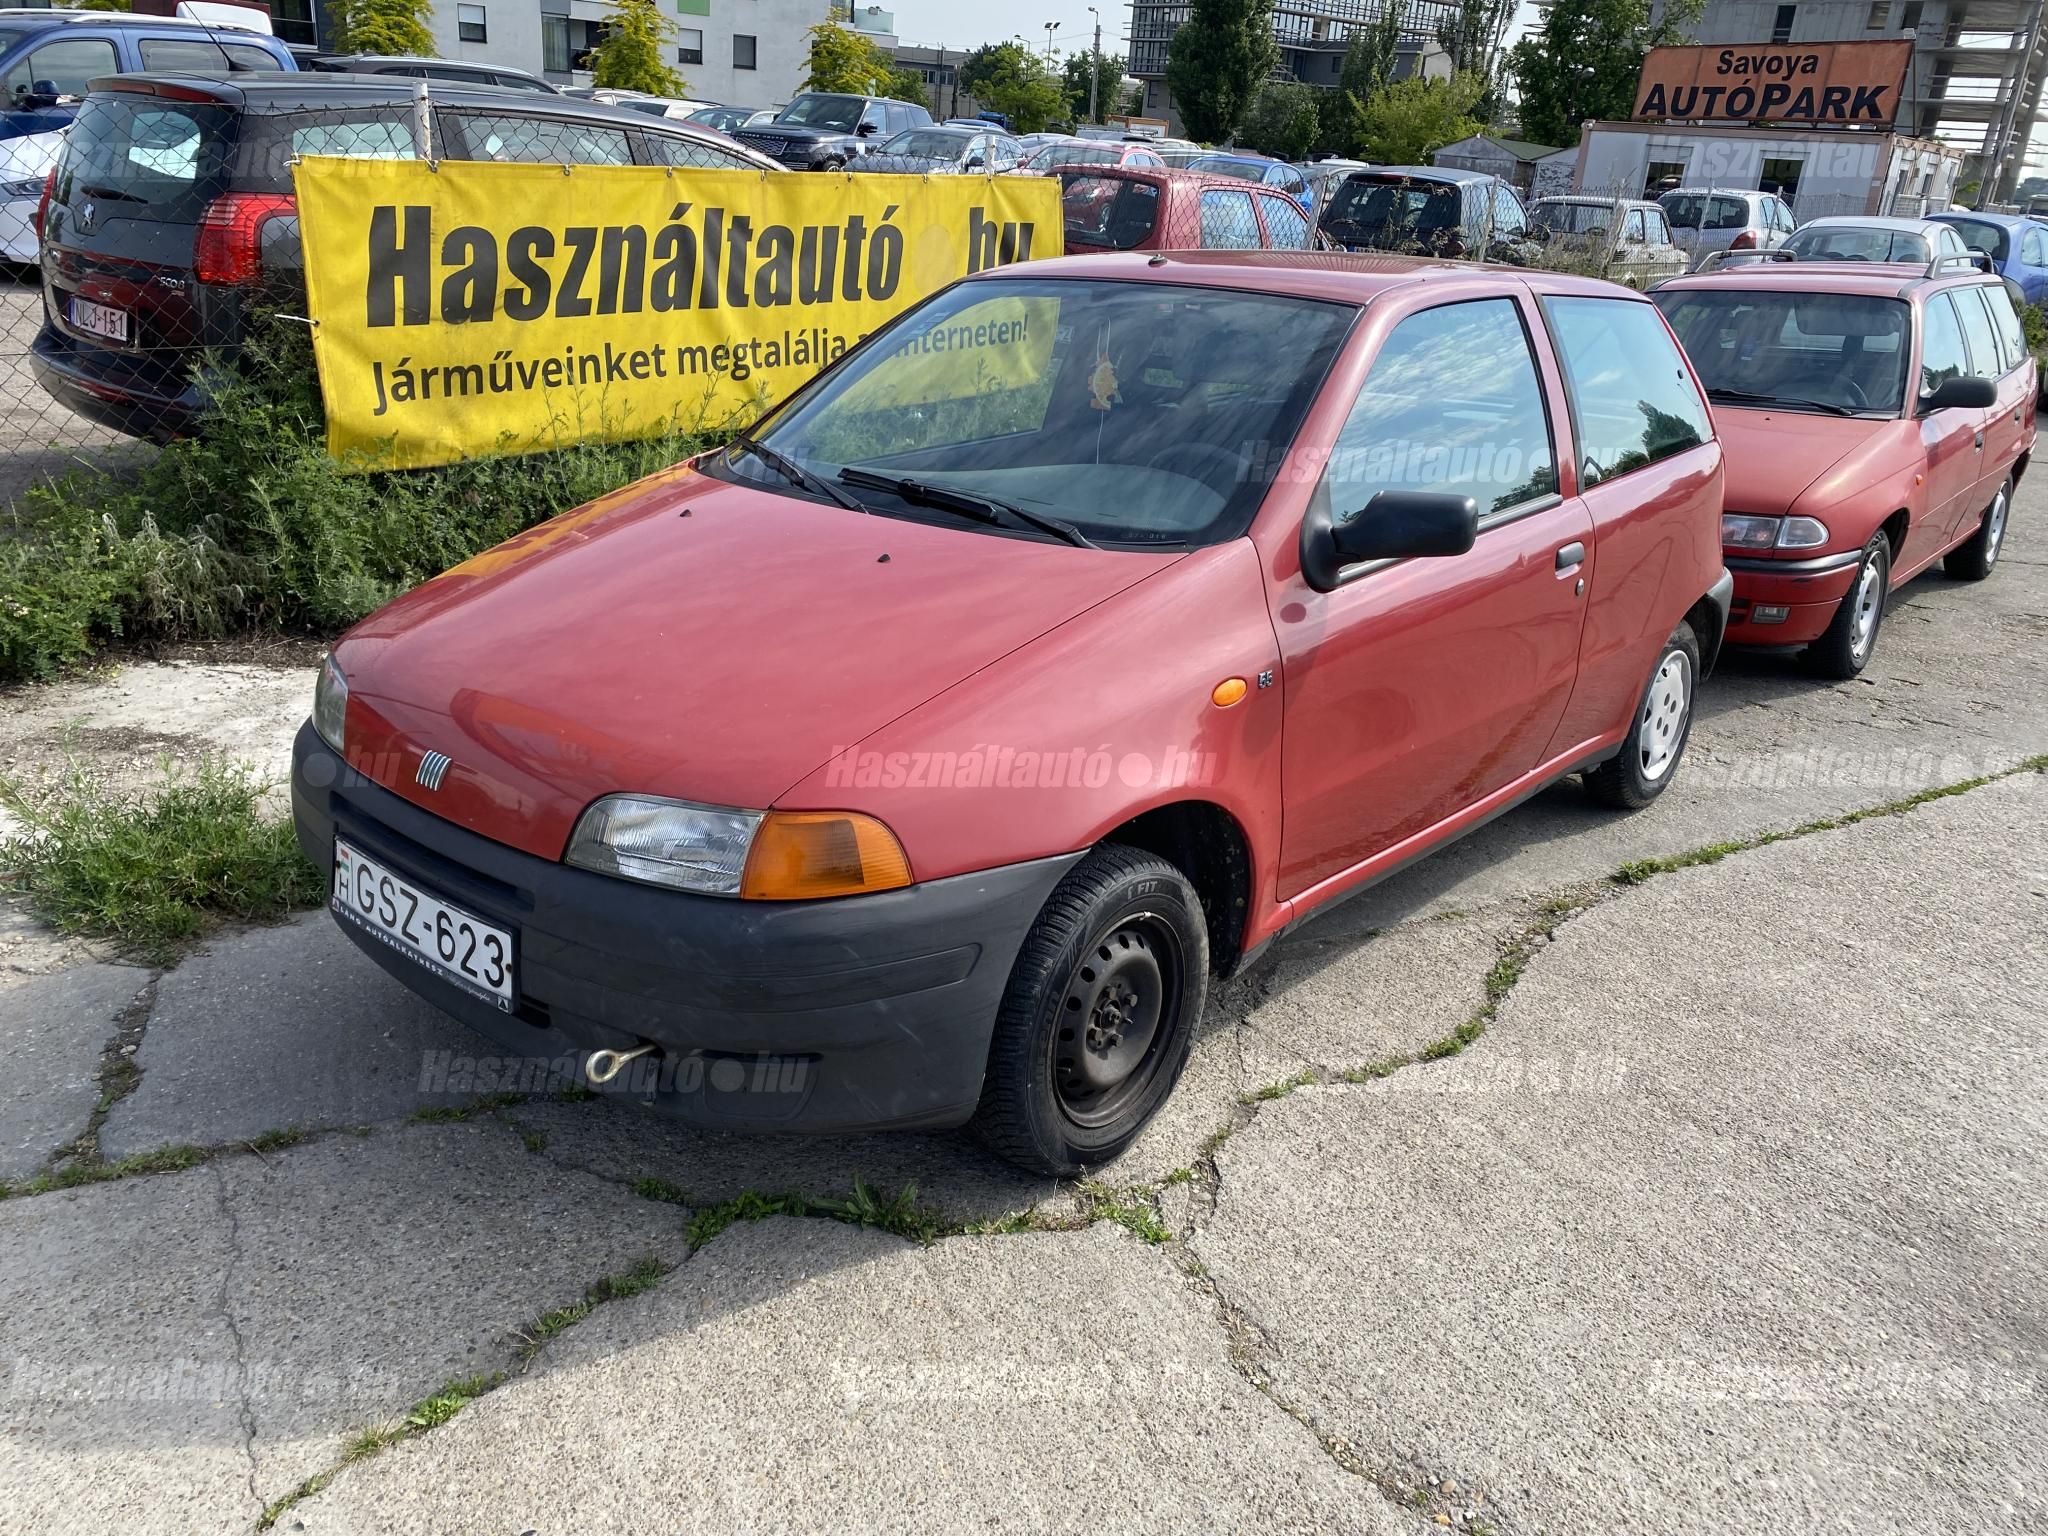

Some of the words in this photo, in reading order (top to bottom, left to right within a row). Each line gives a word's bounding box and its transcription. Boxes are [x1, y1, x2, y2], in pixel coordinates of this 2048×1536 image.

[1639, 78, 1890, 119] AUTÓPARK
[1716, 49, 1819, 82] Savoya
[366, 201, 905, 328] Használtautó
[372, 341, 667, 416] Járműveinket
[677, 327, 847, 381] megtalálja
[356, 863, 505, 988] GSZ-623
